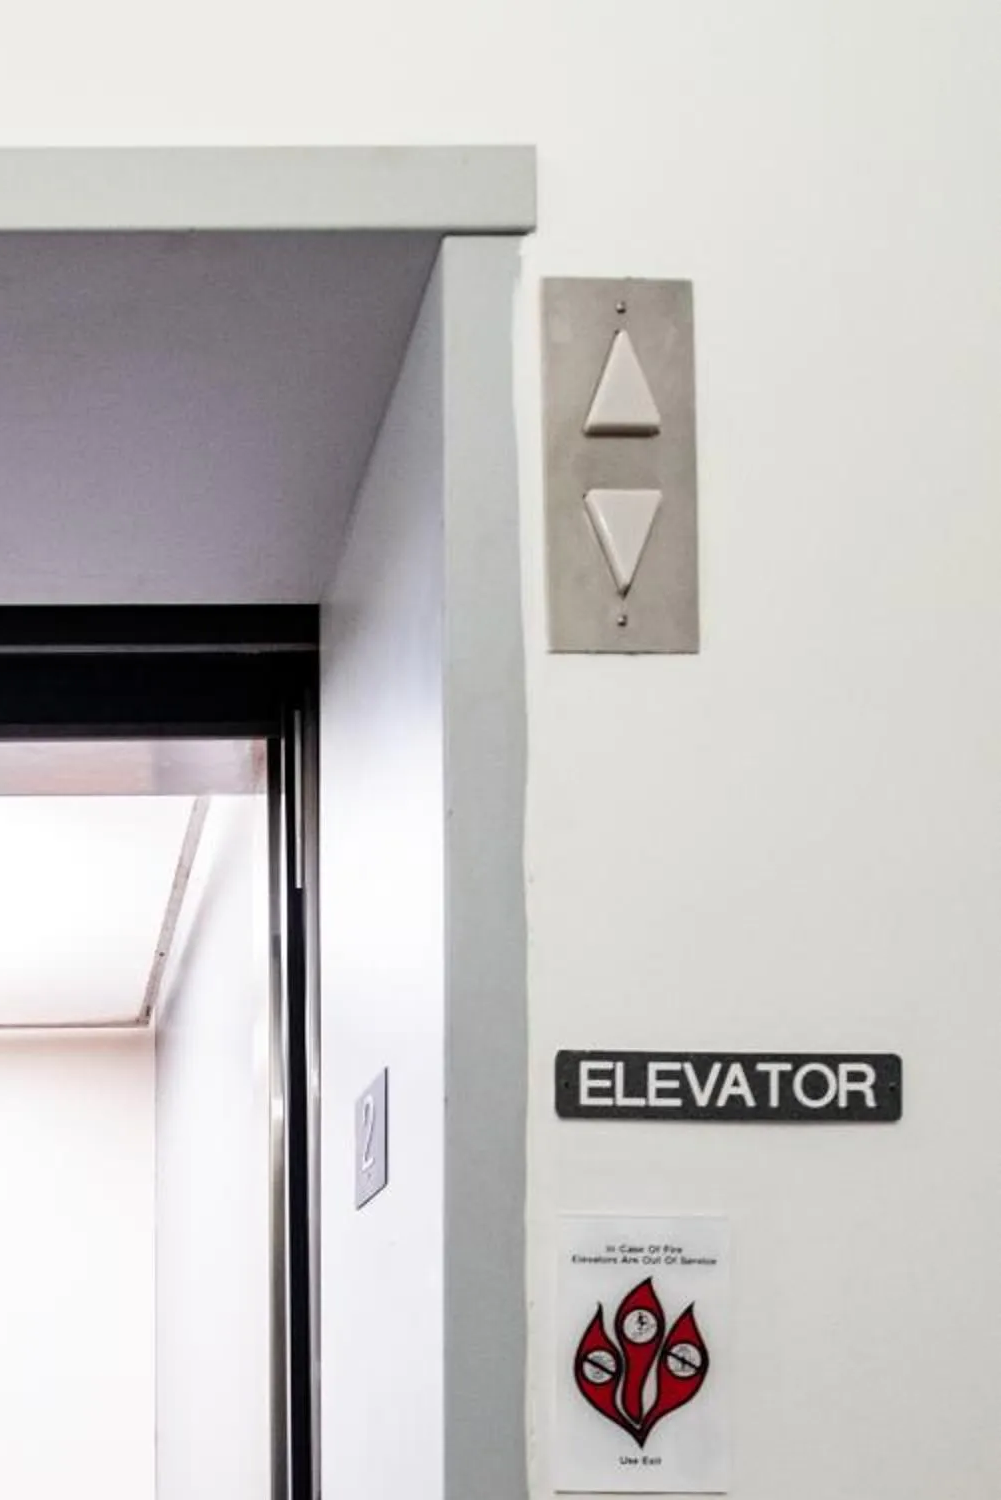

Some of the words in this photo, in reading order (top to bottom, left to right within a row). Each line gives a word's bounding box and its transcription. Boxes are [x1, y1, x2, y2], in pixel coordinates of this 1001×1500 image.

[579, 1060, 877, 1109] ELEVATOR
[619, 1244, 644, 1253] Case
[663, 1244, 683, 1254] Fire
[572, 1255, 617, 1265] Elevators
[621, 1256, 638, 1265] Are
[642, 1256, 661, 1265] Out
[664, 1256, 676, 1265] Of
[681, 1256, 717, 1266] Service
[619, 1456, 639, 1466] Use
[642, 1456, 662, 1466] Exit
